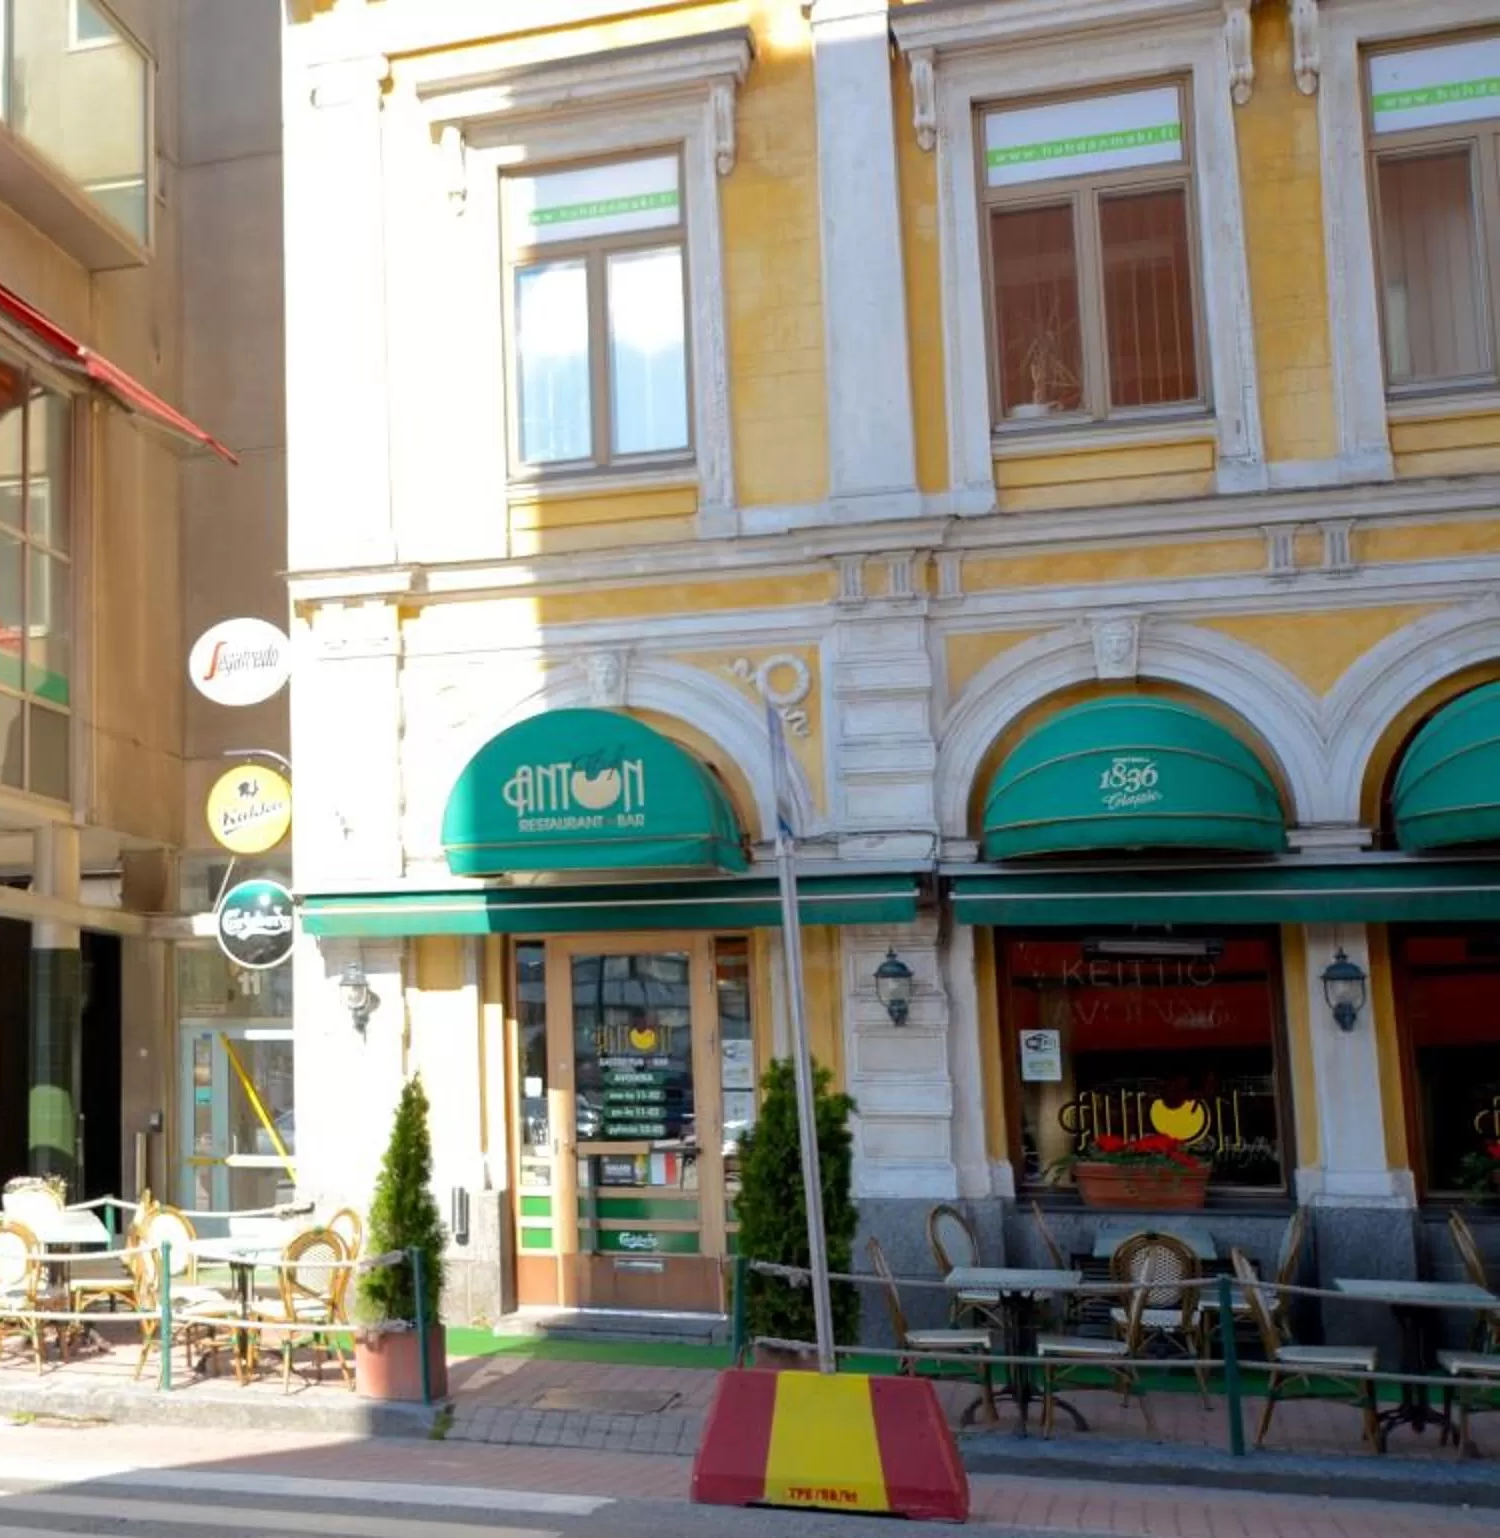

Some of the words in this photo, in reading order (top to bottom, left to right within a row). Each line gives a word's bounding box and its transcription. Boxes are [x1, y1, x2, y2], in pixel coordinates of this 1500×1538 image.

[503, 759, 644, 818] ANTON
[1099, 762, 1159, 792] 1836
[616, 813, 645, 828] BAR
